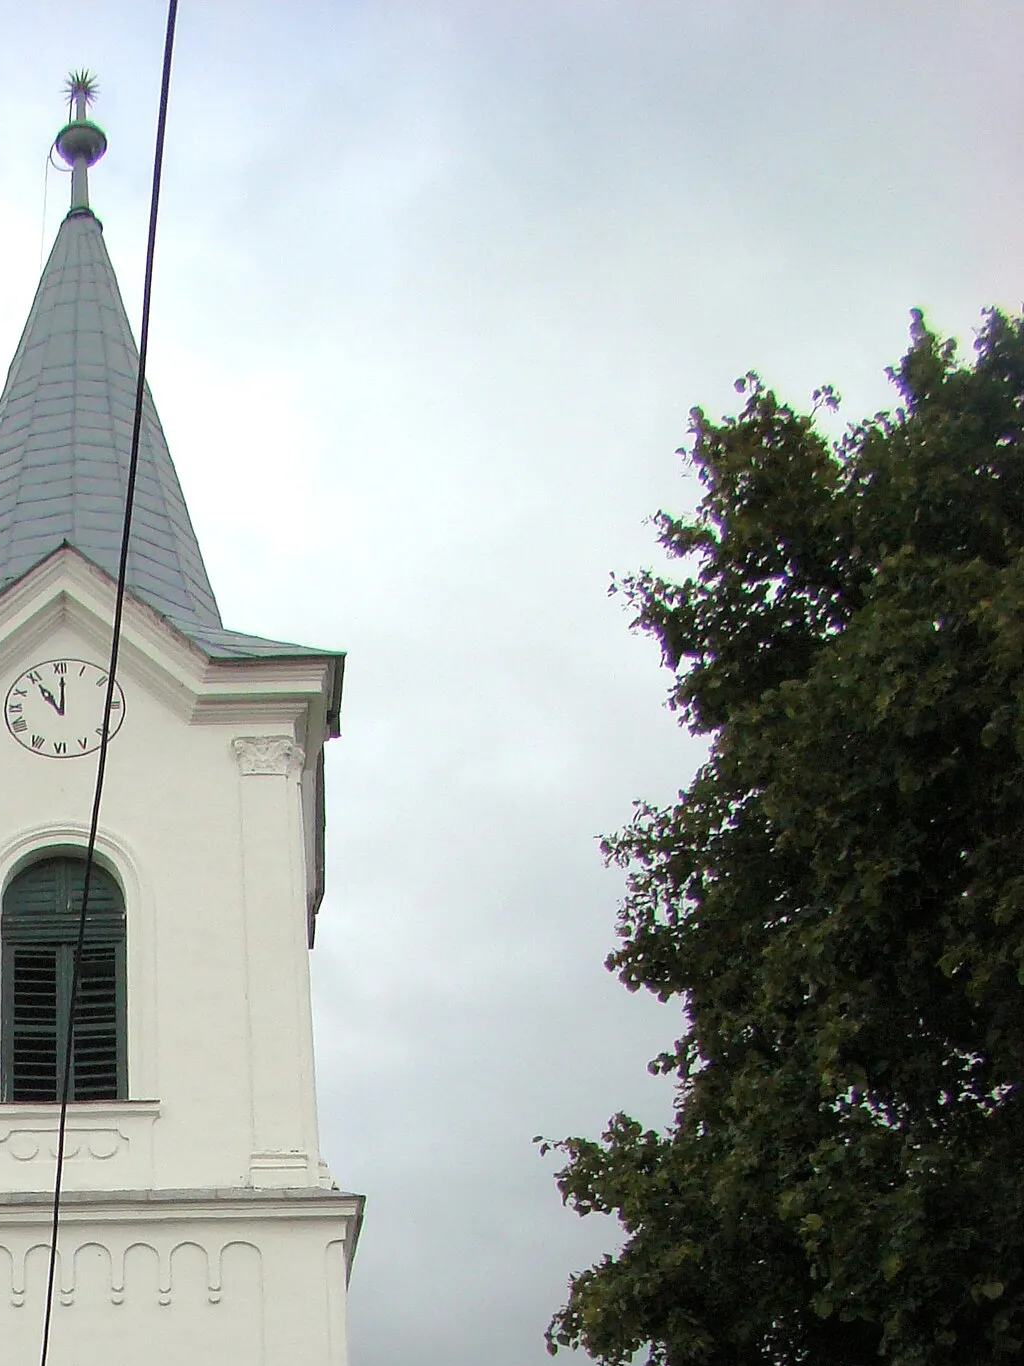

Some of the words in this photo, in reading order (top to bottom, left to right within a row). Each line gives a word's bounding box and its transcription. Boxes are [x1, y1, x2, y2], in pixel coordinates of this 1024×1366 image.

[54, 663, 66, 674] XII
[79, 666, 85, 676] I
[27, 671, 42, 684] XI
[96, 676, 108, 687] II
[13, 688, 27, 697] X
[9, 703, 22, 713] IX
[32, 735, 45, 749] VII
[78, 738, 87, 749] V
[54, 742, 66, 754] VI
